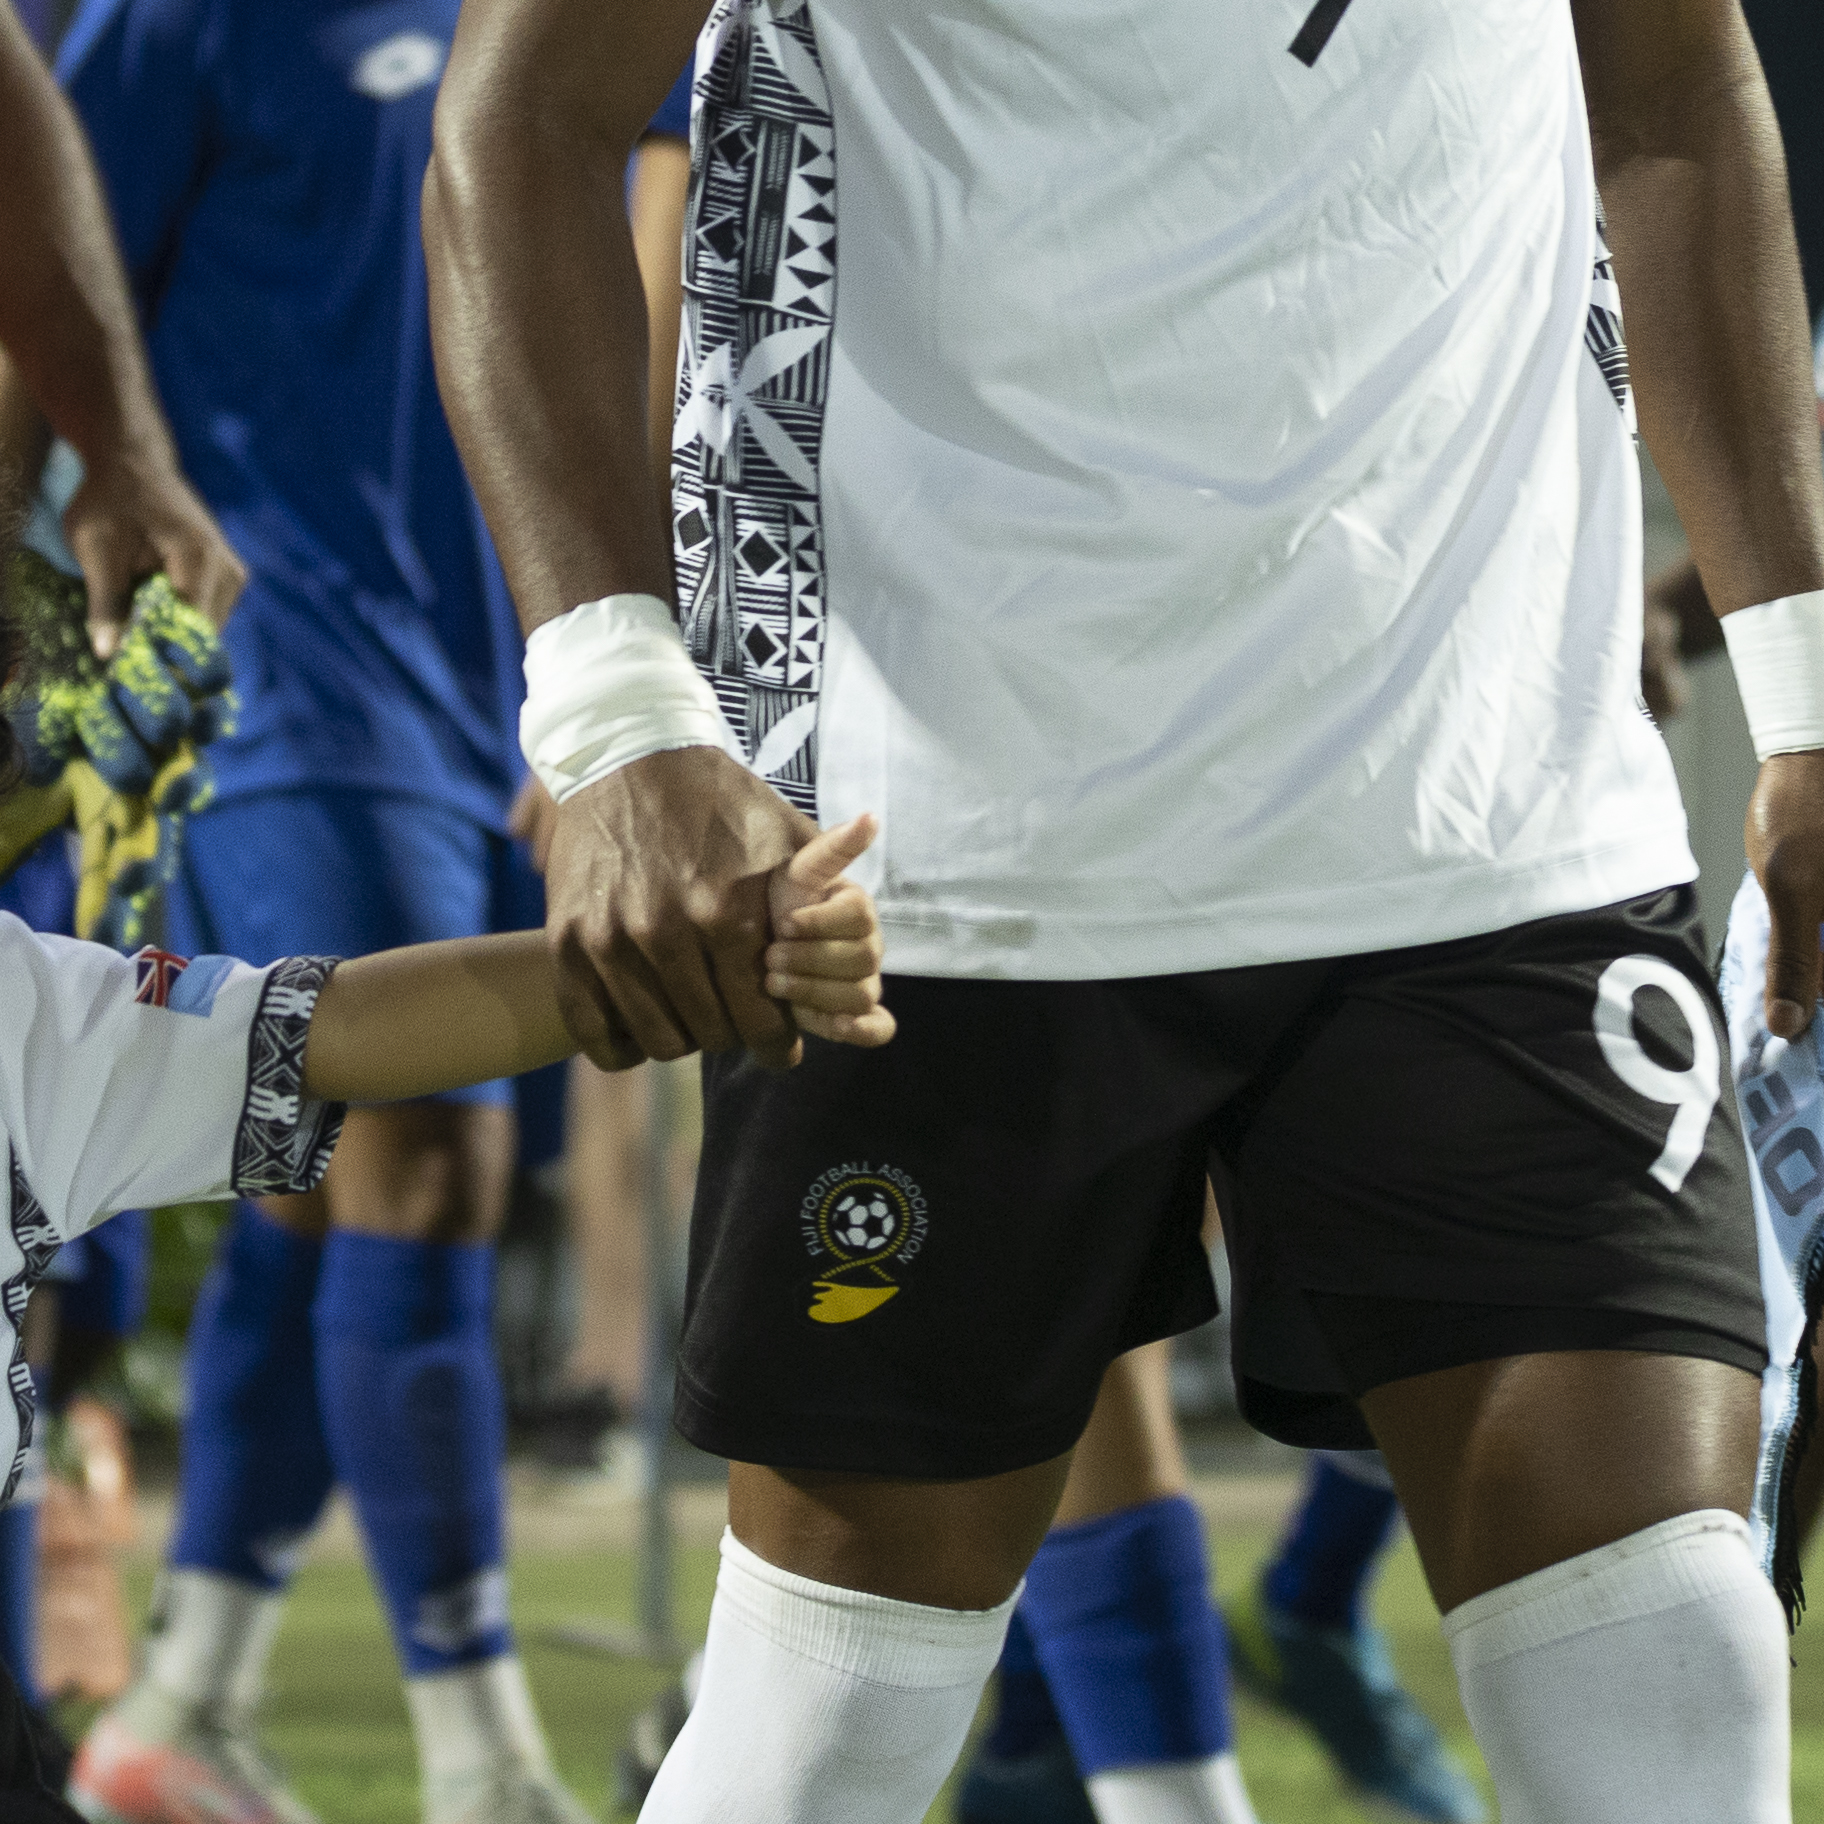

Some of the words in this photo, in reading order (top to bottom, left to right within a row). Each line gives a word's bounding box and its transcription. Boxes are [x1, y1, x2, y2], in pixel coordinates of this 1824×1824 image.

[1593, 953, 1721, 1195] 9
[800, 1161, 873, 1220] FOOTBALL
[877, 1163, 929, 1264] ASSOCIATION
[801, 1226, 824, 1256] FIJI
